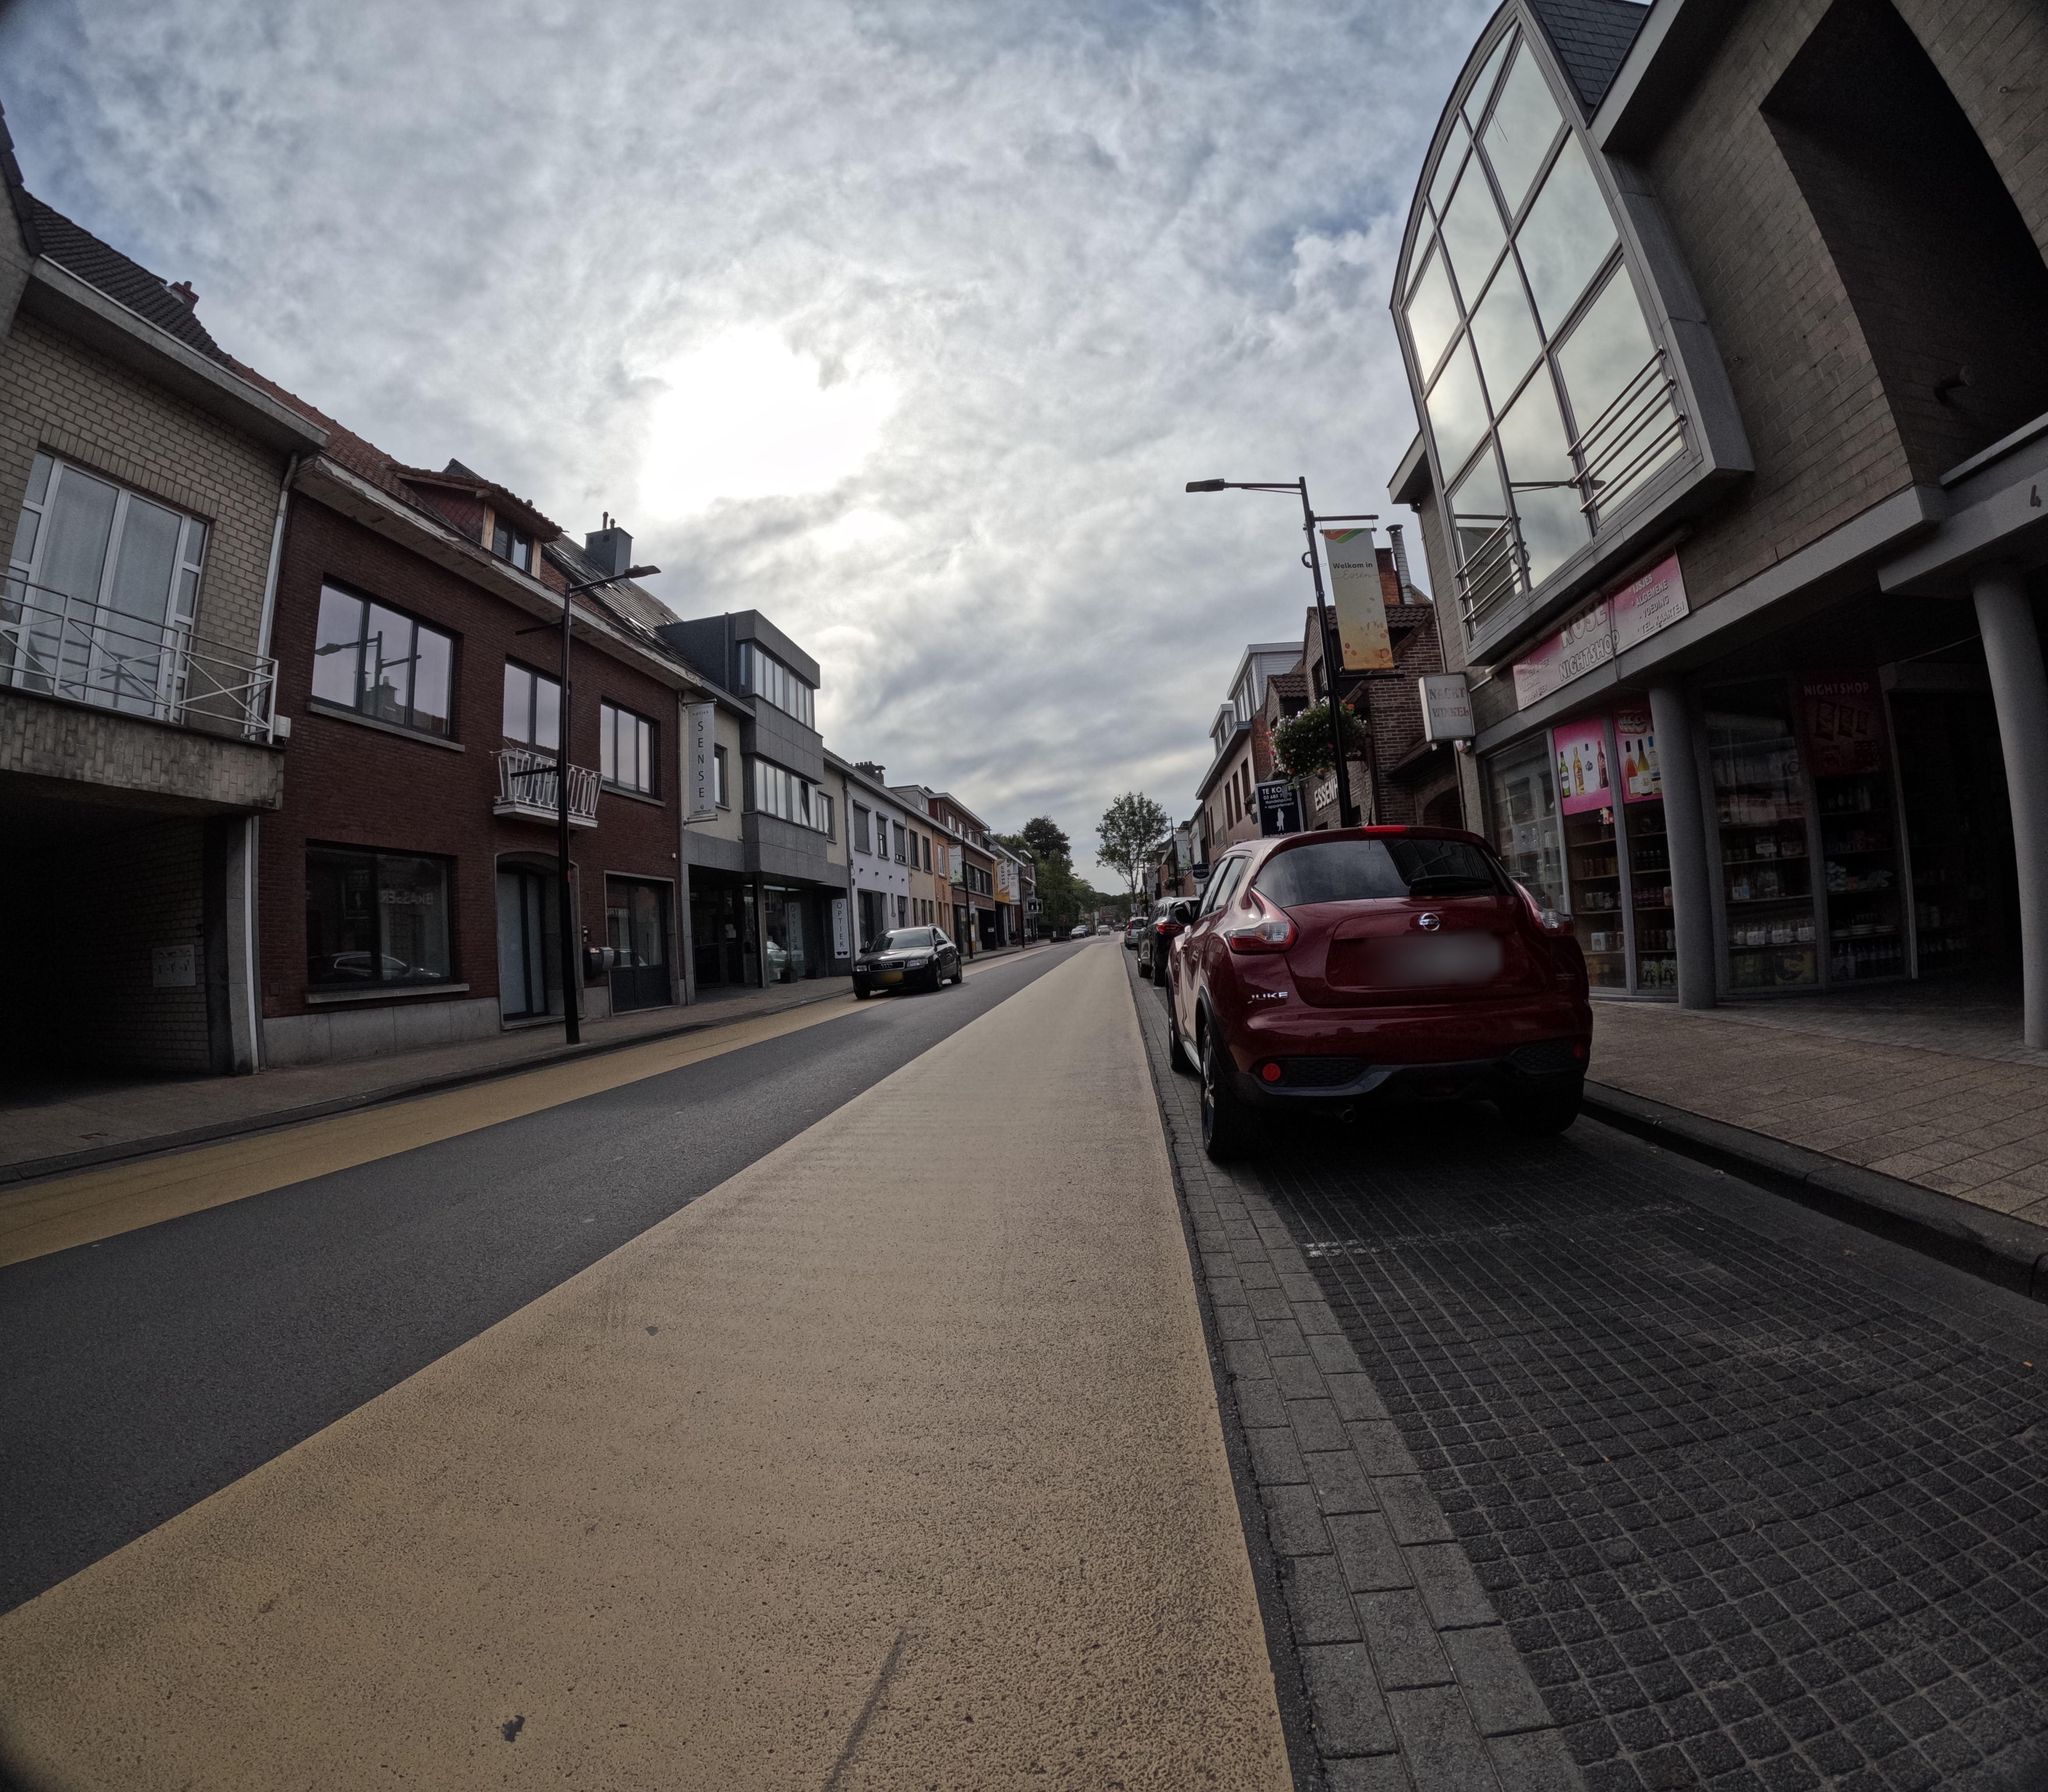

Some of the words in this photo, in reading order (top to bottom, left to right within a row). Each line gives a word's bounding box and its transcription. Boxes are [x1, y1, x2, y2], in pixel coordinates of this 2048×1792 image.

[1332, 561, 1364, 570] Welkom
[1635, 579, 1669, 608] ALGEMENE
[1558, 629, 1620, 682] NIGHTSHOP
[1803, 681, 1870, 697] NIGHTSHOP
[696, 720, 706, 798] SENSE
[1262, 787, 1270, 795] TE
[836, 902, 845, 948] OPTIEK
[1247, 991, 1289, 1005] JUKE
